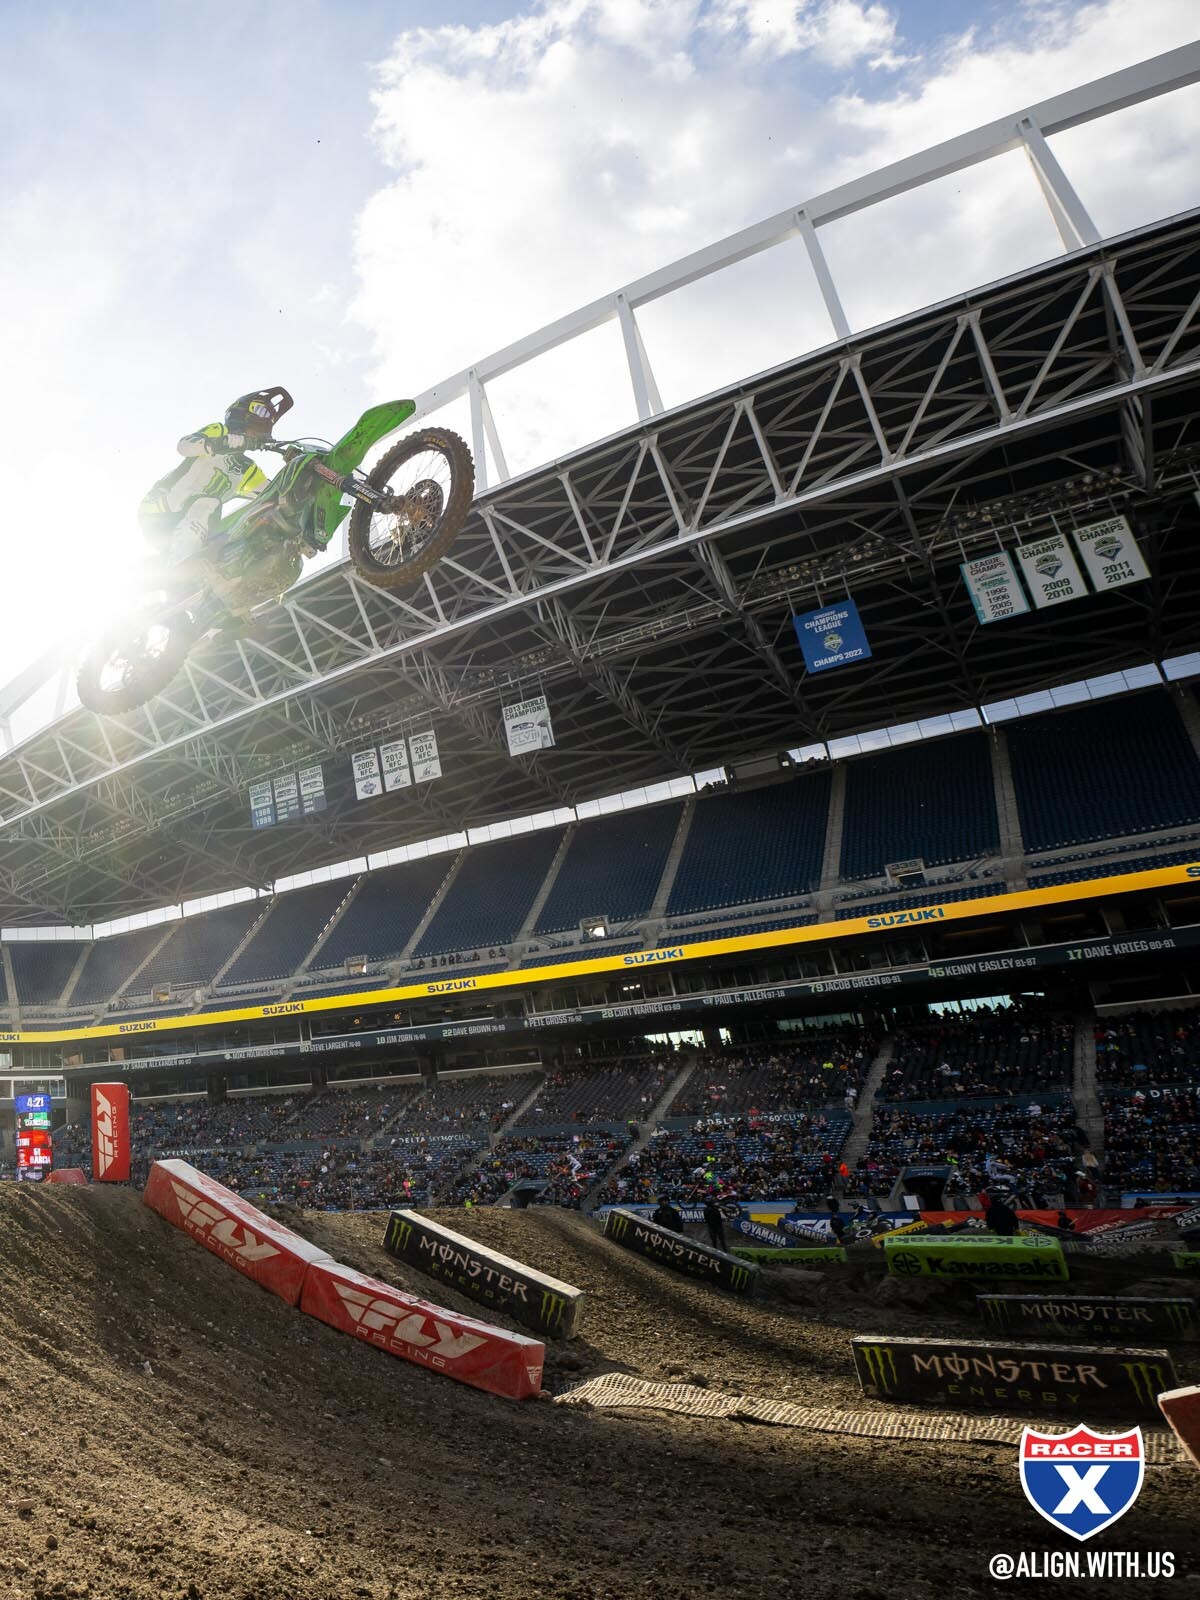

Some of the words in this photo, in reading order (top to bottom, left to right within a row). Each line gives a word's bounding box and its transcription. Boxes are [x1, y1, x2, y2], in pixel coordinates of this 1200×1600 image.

[1079, 523, 1125, 542] CHAMPS
[1022, 542, 1064, 560] CHAMPS
[969, 556, 1000, 570] LEAGUE
[970, 562, 1005, 576] CHAMPS
[1102, 561, 1130, 575] 2011
[1106, 569, 1135, 583] 2014
[985, 586, 1007, 597] 1995
[1042, 578, 1071, 592] 2009
[1046, 587, 1074, 600] 2010
[804, 611, 849, 629] CHAMPIONS
[992, 607, 1014, 618] 2007
[814, 620, 843, 633] LEAGUE
[813, 653, 844, 667] CHAMPS
[844, 648, 863, 659] 2022
[504, 705, 520, 715] 2013
[522, 697, 545, 709] WORLD
[505, 704, 546, 721] CHAMPIONS
[415, 743, 433, 754] 2014
[418, 751, 431, 759] NFC
[385, 752, 403, 762] 2013
[389, 760, 402, 768] NFC
[357, 761, 374, 771] 2005
[360, 768, 373, 776] NFC
[867, 908, 945, 928] SUZUKI
[623, 948, 684, 965] SUZUKI
[1066, 949, 1083, 960] 17
[1084, 945, 1113, 959] DAVE
[1113, 940, 1149, 954] KRIEG
[928, 967, 945, 978] 45
[945, 963, 977, 976] KENNY
[978, 958, 1014, 972] EASLEY
[427, 979, 477, 993] SUZUKI
[808, 984, 824, 993] 79
[824, 979, 850, 992] JACOB
[852, 976, 880, 989] GREEN
[715, 994, 733, 1005] PAUL
[743, 991, 767, 1002] ALLEN
[262, 1003, 304, 1016] SUZUKI
[602, 1010, 614, 1019] 28
[614, 1007, 631, 1018] CURT
[633, 1004, 663, 1016] WARNER
[119, 1021, 157, 1033] SUZUKI
[529, 1017, 545, 1027] PETE
[546, 1015, 567, 1026] GROSS
[442, 1029, 453, 1037] 22
[453, 1027, 468, 1036] DAVE
[469, 1025, 491, 1035] BROWN
[309, 1043, 325, 1052] STEVE
[326, 1041, 348, 1051] LARGENT
[95, 1088, 114, 1177] FLY
[171, 1180, 282, 1261] FLY
[679, 1210, 705, 1220] YAMAH
[751, 1224, 787, 1246] YAMAHA
[794, 1228, 828, 1243] YAMAHA
[184, 1220, 248, 1267] RACING
[634, 1227, 720, 1273] MONSTER
[419, 1235, 529, 1302] MONSTER
[927, 1257, 1064, 1276] Kawasaki
[431, 1262, 509, 1305] ENERGY
[1021, 1302, 1156, 1322] MONSTER
[332, 1281, 490, 1359] FLY
[356, 1325, 446, 1368] RACING
[912, 1353, 1109, 1388] MONSTER
[948, 1384, 1080, 1403] ENERGY
